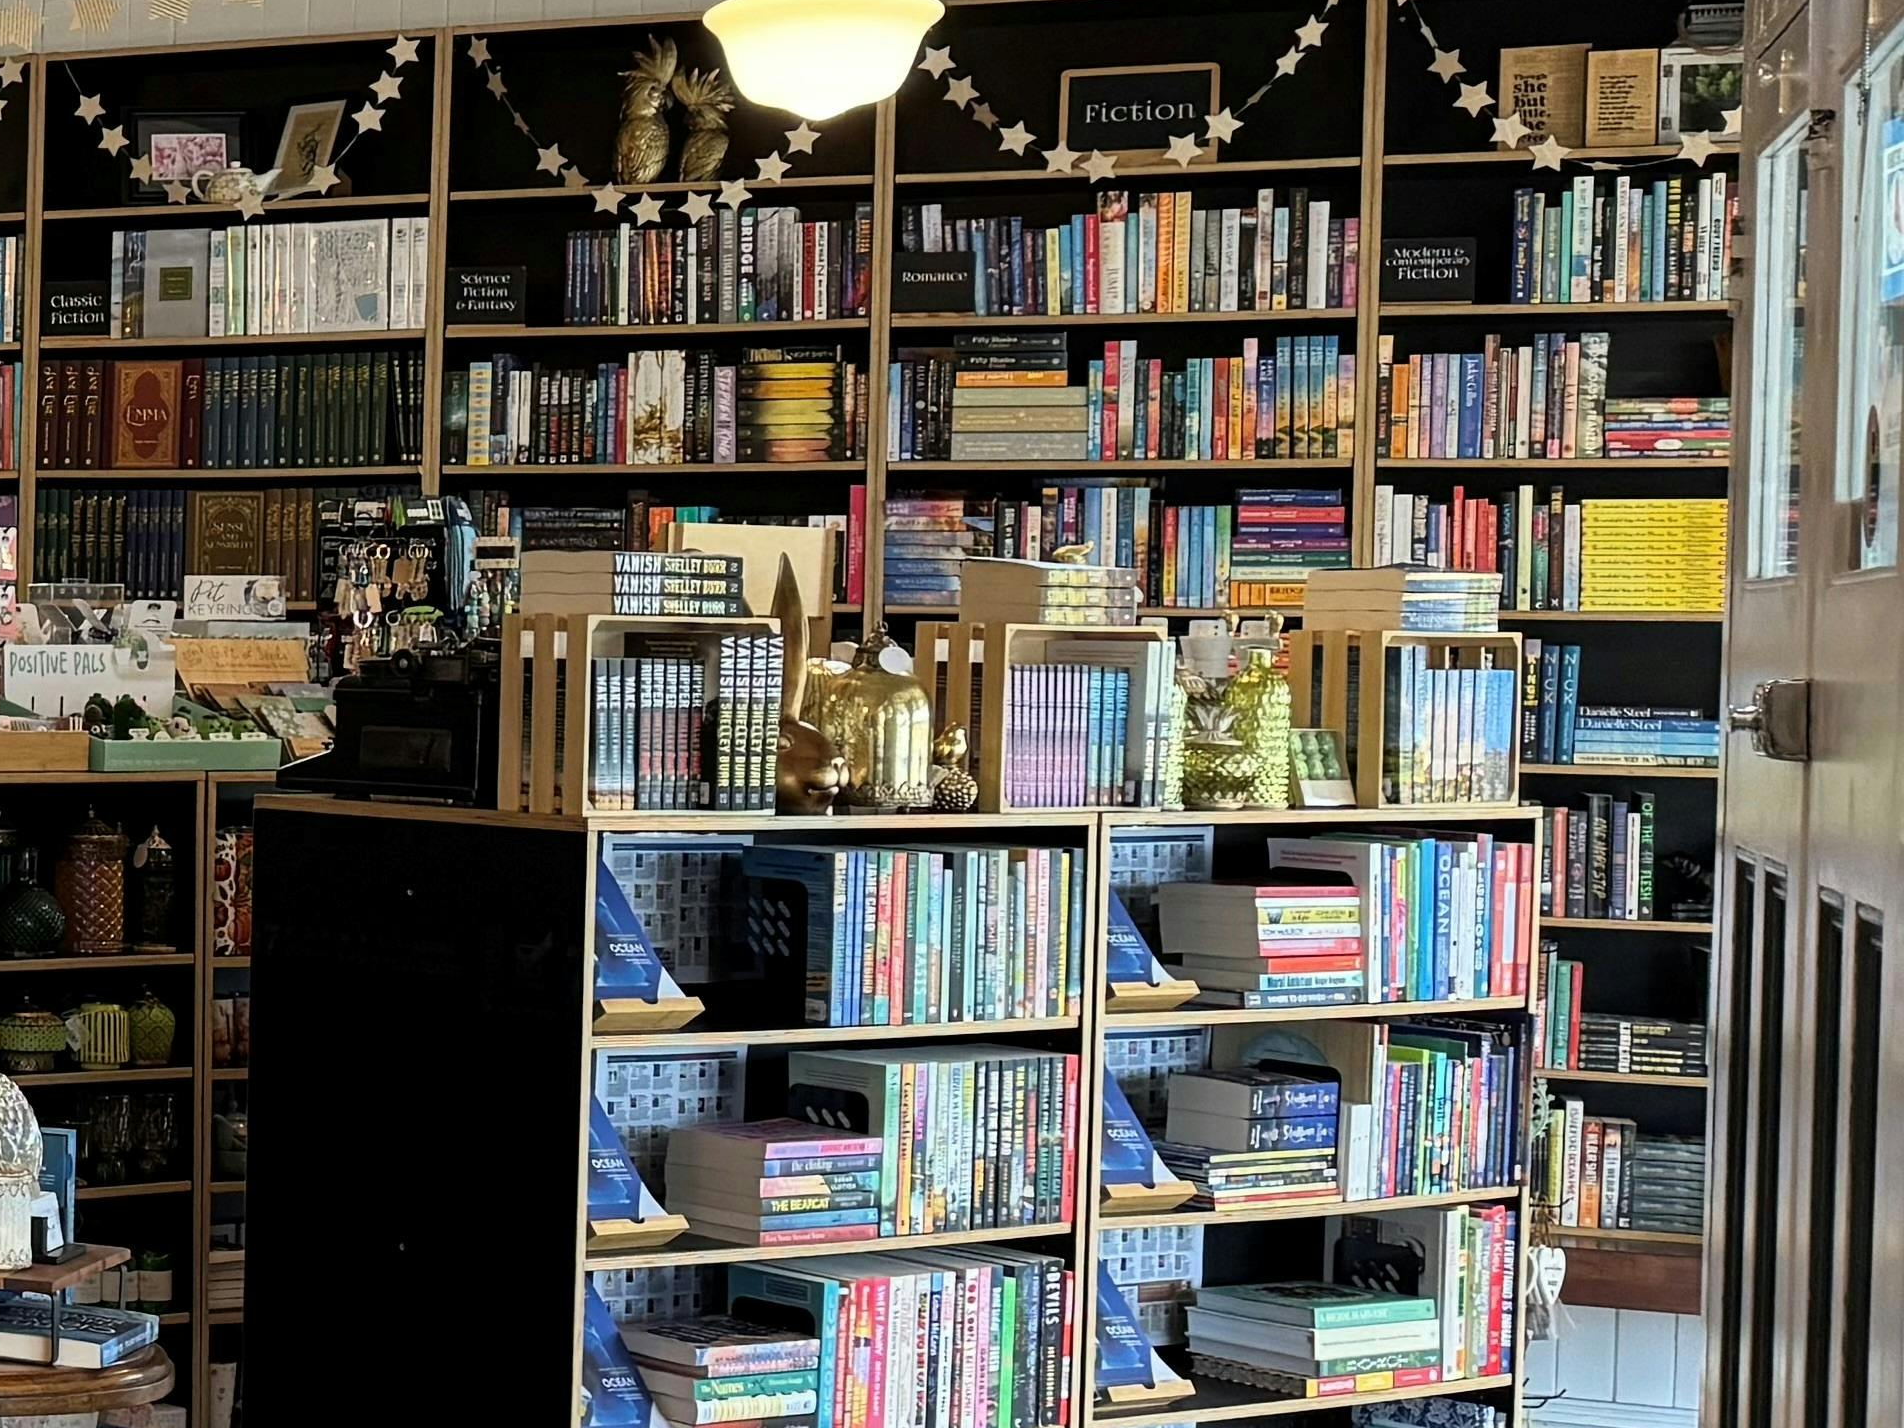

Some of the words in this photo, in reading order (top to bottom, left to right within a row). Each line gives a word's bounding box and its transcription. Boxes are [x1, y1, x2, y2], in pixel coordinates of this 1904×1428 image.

[1084, 98, 1197, 125] Fiction
[741, 216, 753, 275] BRIDGE
[460, 272, 511, 286] Science
[902, 271, 967, 283] Romance
[1397, 265, 1459, 281] Fiction
[50, 293, 104, 309] Classic
[126, 404, 167, 425] EMMA
[211, 521, 246, 535] SENSE
[615, 555, 662, 573] VANISH
[664, 557, 702, 572] SHELLEY
[9, 649, 71, 676] POSITIVE
[72, 646, 107, 675] PALS
[609, 942, 646, 954] OCEAN
[790, 1197, 830, 1212] BEARCAT
